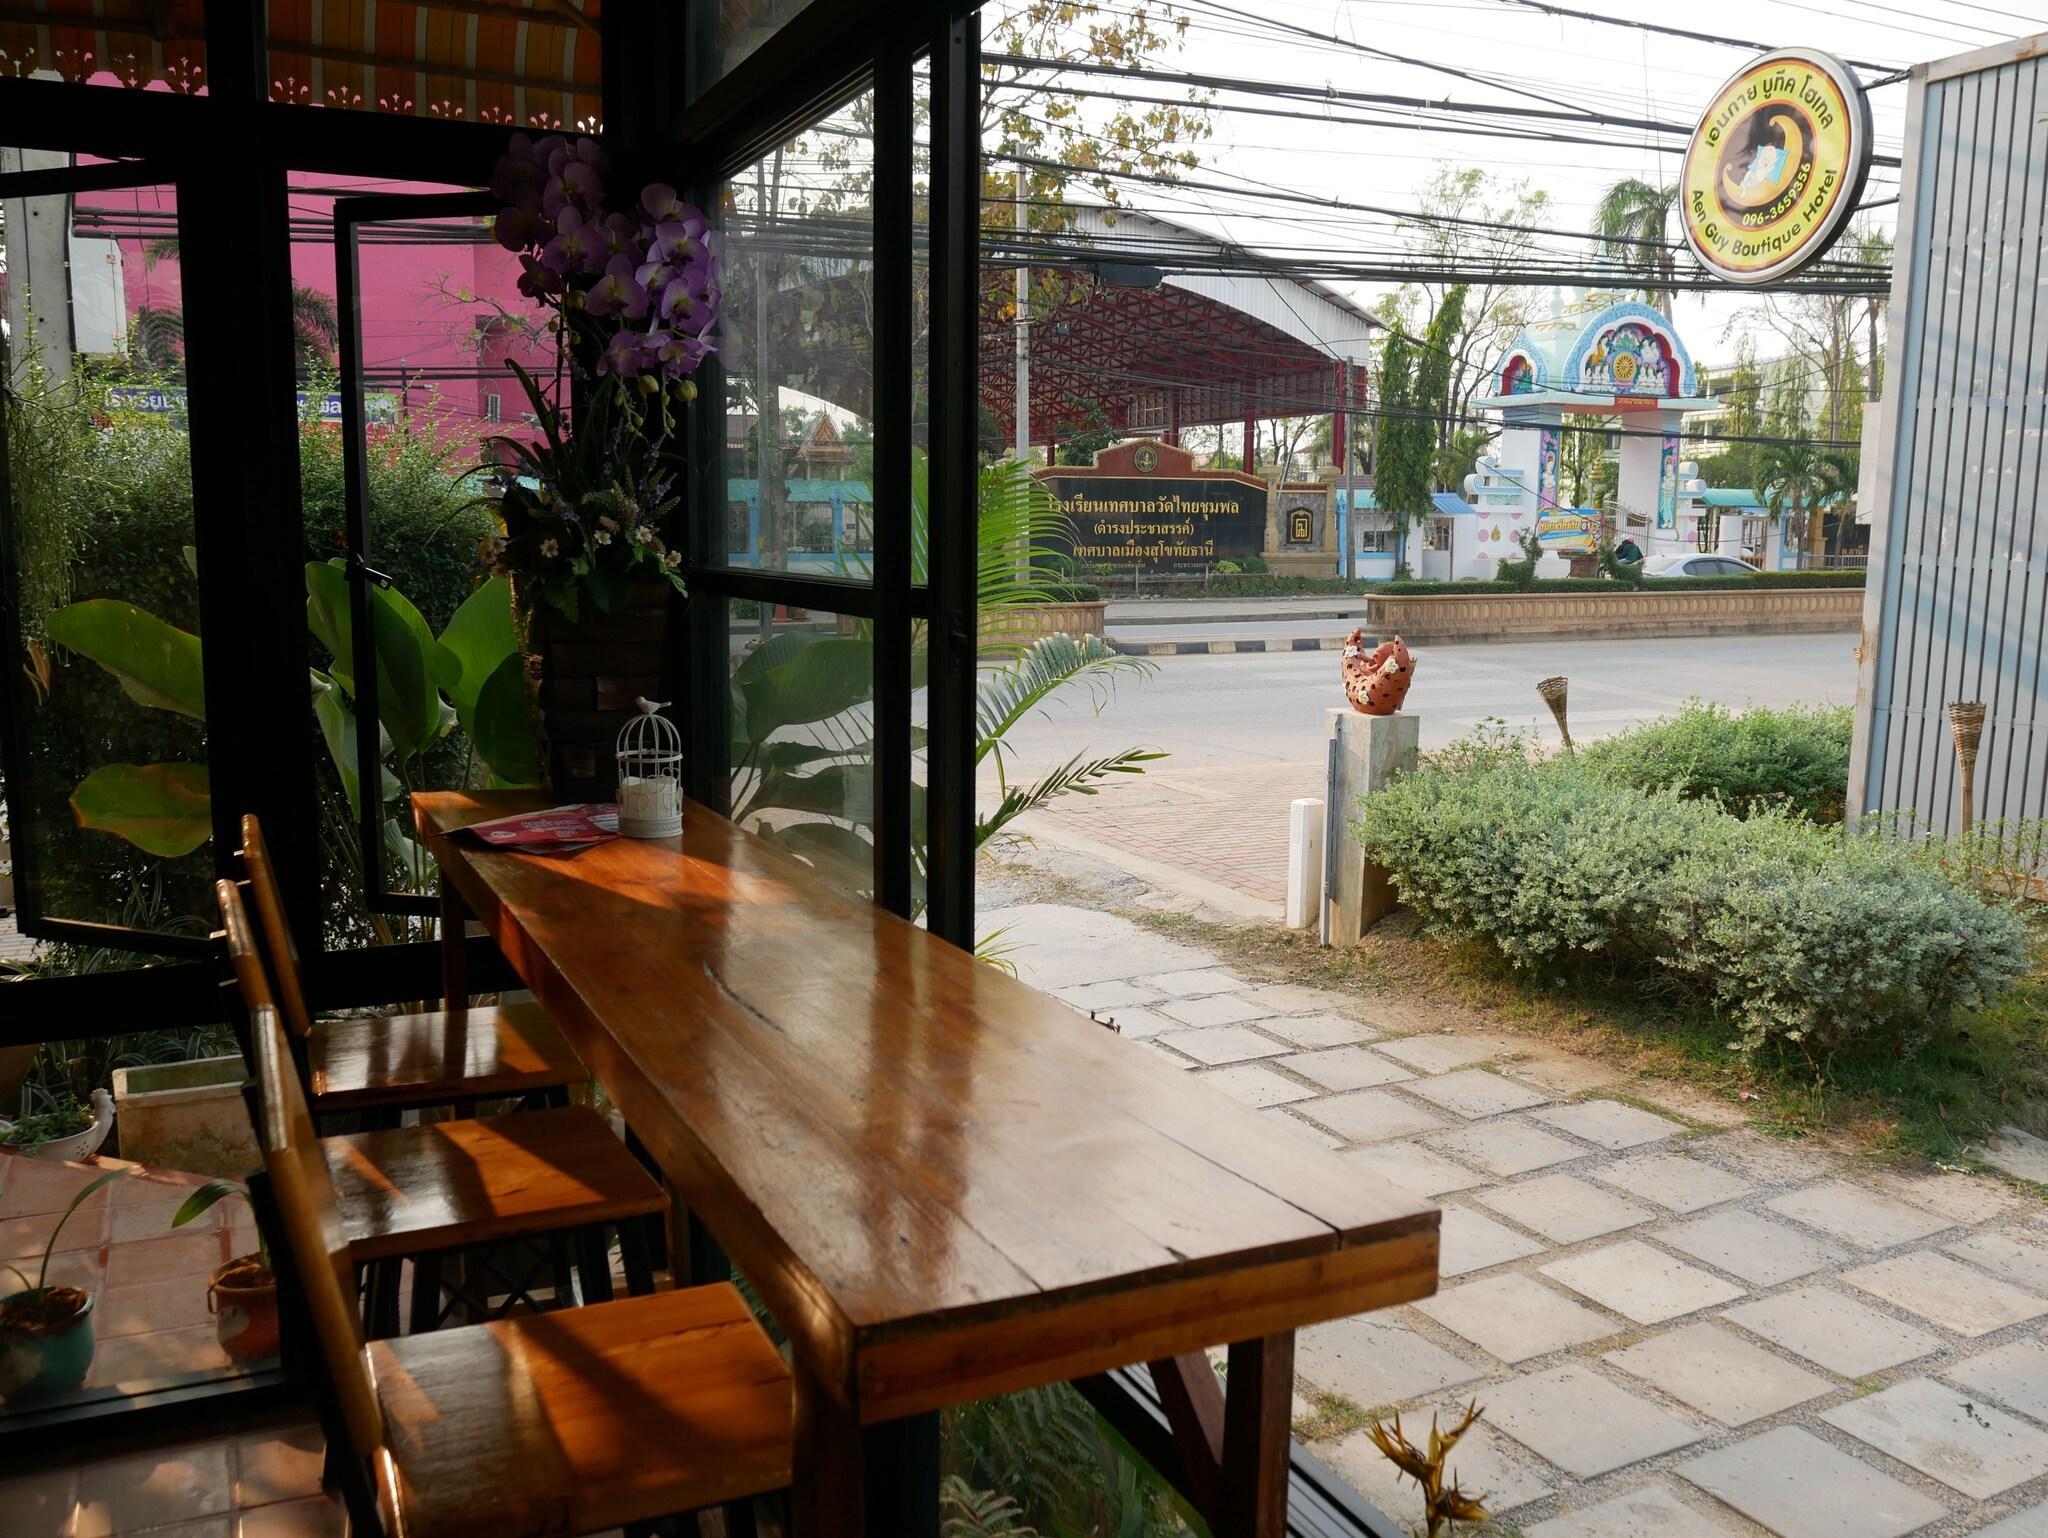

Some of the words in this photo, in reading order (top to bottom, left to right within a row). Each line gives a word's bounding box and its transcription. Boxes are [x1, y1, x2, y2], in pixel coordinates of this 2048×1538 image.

[1705, 84, 1757, 147] เอนกาย
[1799, 74, 1834, 130] โฮเทล
[1692, 189, 1707, 224] Aen
[1705, 223, 1729, 253] Guy
[1731, 222, 1802, 257] Boutique
[1803, 168, 1838, 223] Hotel
[1742, 162, 1812, 227] 096-3659356
